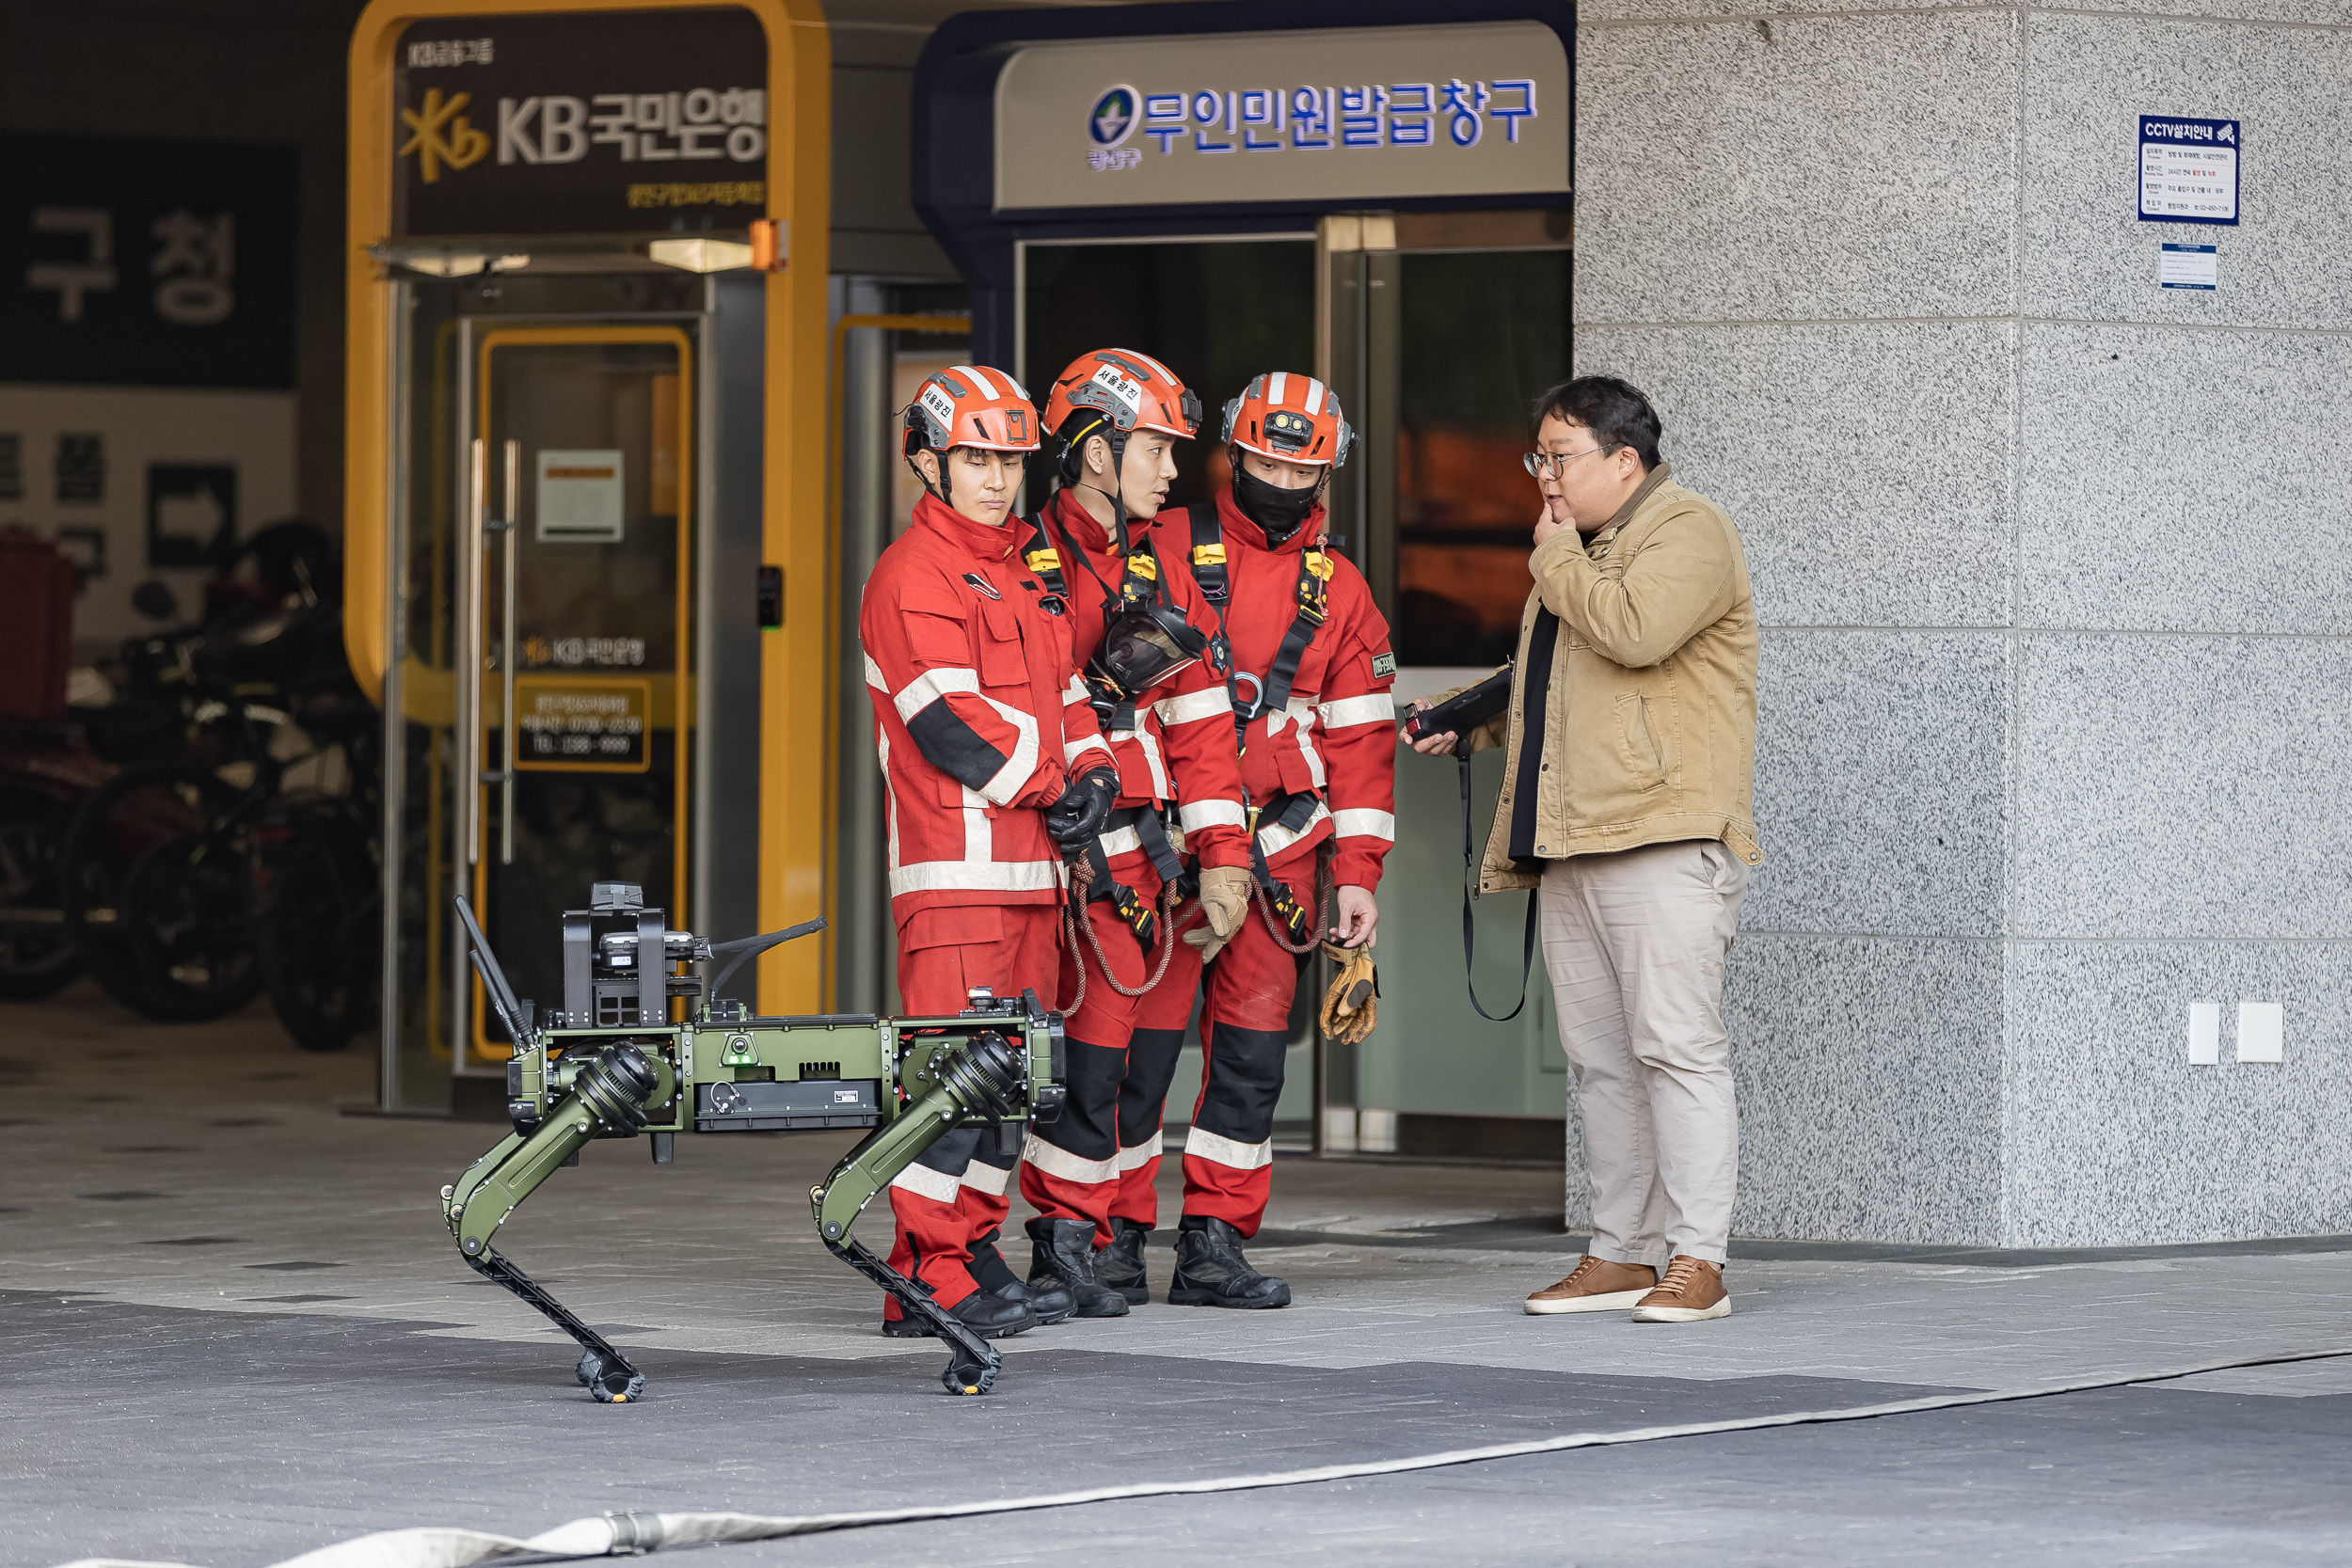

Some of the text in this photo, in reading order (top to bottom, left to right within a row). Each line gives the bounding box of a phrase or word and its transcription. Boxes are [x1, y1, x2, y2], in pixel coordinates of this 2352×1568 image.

[497, 87, 767, 166] KB국민은행
[1144, 78, 1538, 156] 무인민원발급창구
[2145, 122, 2213, 141] CCTV설치안내
[1098, 370, 1138, 400] 서울광진
[924, 389, 952, 418] 서울광진
